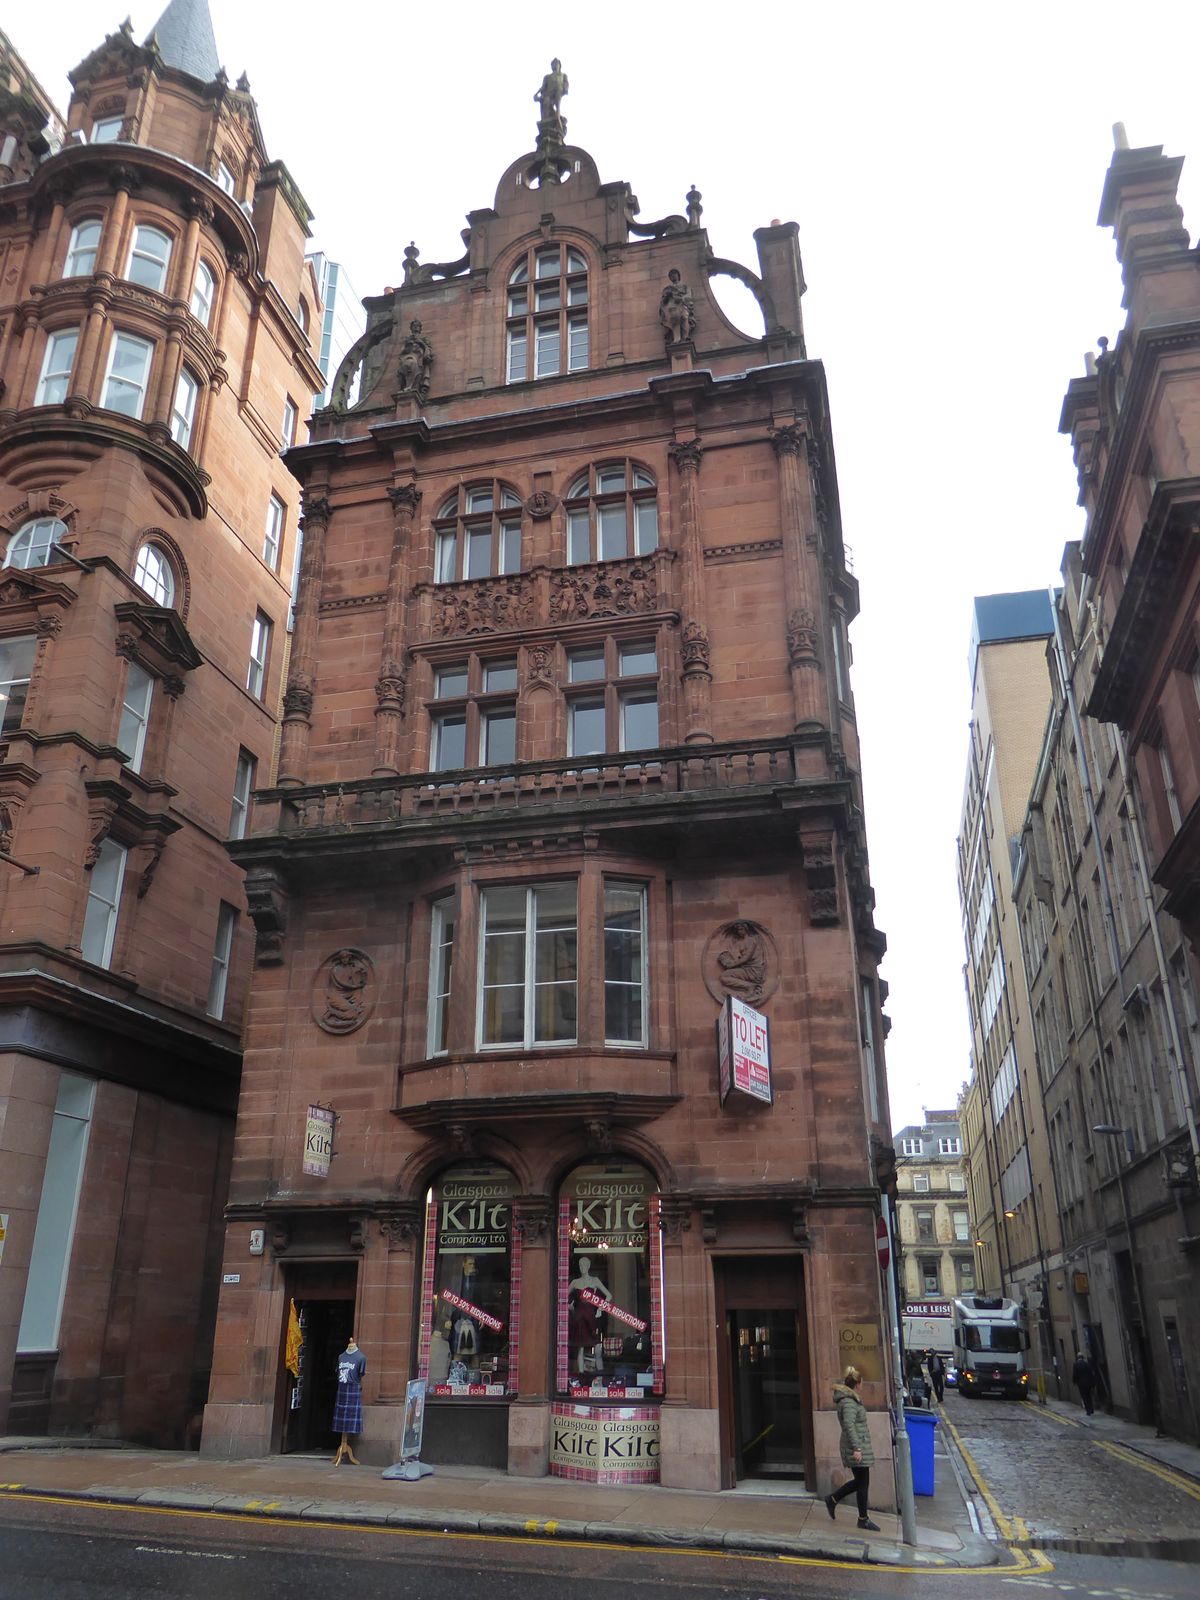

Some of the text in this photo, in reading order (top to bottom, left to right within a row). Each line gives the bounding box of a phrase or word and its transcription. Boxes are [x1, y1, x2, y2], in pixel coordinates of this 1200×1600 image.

[733, 1012, 747, 1042] TO
[749, 1021, 767, 1054] LET
[306, 1132, 332, 1155] Kilt
[442, 1183, 509, 1199] Glasgow
[575, 1182, 644, 1199] Glasgow
[441, 1200, 508, 1230] Kilt
[576, 1198, 645, 1230] Kilt
[440, 1234, 488, 1246] Company
[443, 1289, 452, 1299] UP
[450, 1294, 459, 1304] TO
[469, 1306, 502, 1329] REDUCTIONS
[582, 1290, 592, 1300] UP
[590, 1294, 600, 1304] TO
[611, 1306, 646, 1330] REDUCTIONS
[436, 1387, 451, 1395] sale
[453, 1387, 468, 1395] sale
[470, 1387, 485, 1395] sale
[573, 1388, 588, 1397] sale
[591, 1388, 606, 1397] sale
[609, 1388, 624, 1397] sale
[553, 1416, 598, 1431] Glasgow
[603, 1422, 660, 1434] Glasgow
[553, 1430, 598, 1457] Kilt
[603, 1435, 660, 1457] Kilt
